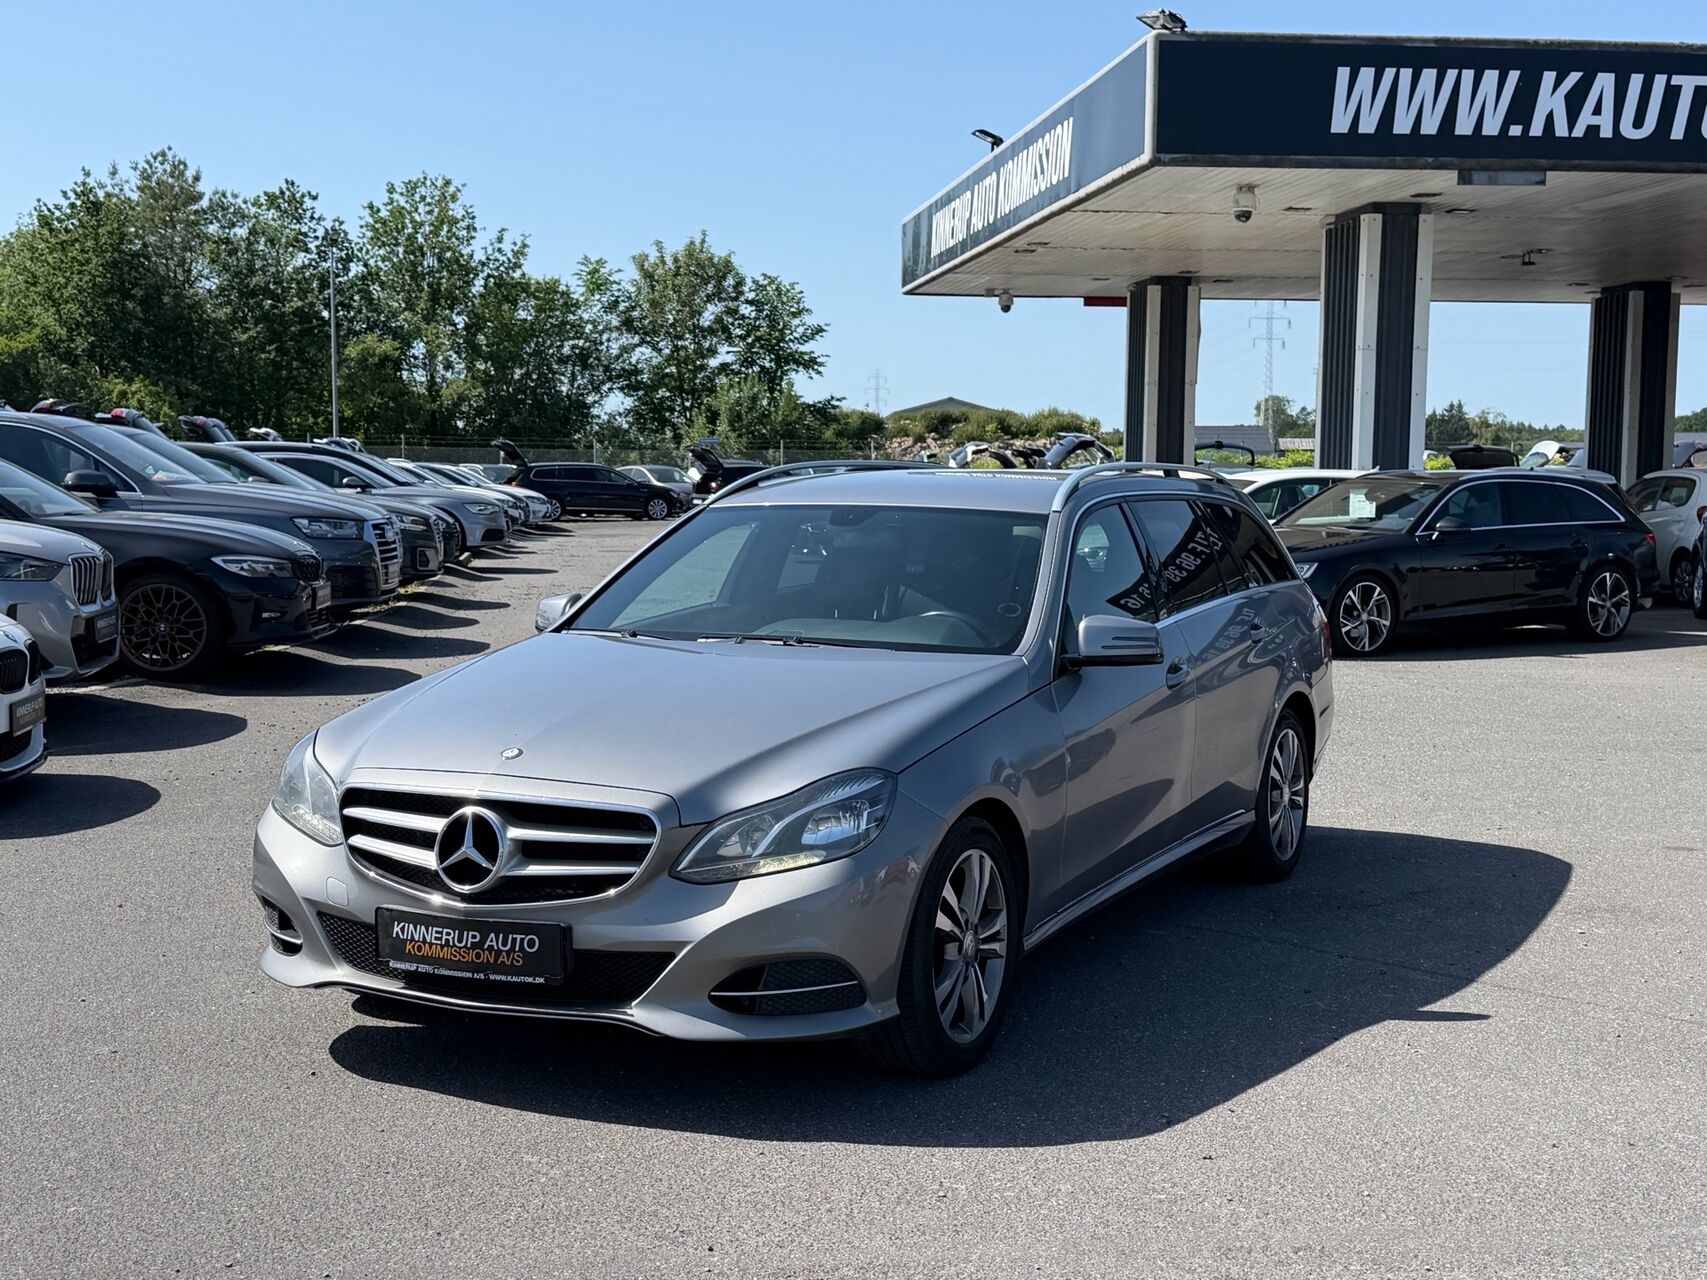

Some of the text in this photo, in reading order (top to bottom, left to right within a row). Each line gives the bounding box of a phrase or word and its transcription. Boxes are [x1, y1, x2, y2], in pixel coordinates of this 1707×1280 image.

[1330, 66, 1707, 140] WWW.KAUT
[931, 116, 1074, 259] KINNERUP AUTO KOMMISSION
[392, 920, 539, 953] KINNERUP AUTO
[405, 940, 524, 967] KOMMISSION A/S
[417, 965, 434, 973] AUTO
[434, 967, 473, 979] KOMMISSION
[473, 971, 485, 980] A/S
[488, 973, 546, 984] WWW.KAUTOK.DK
